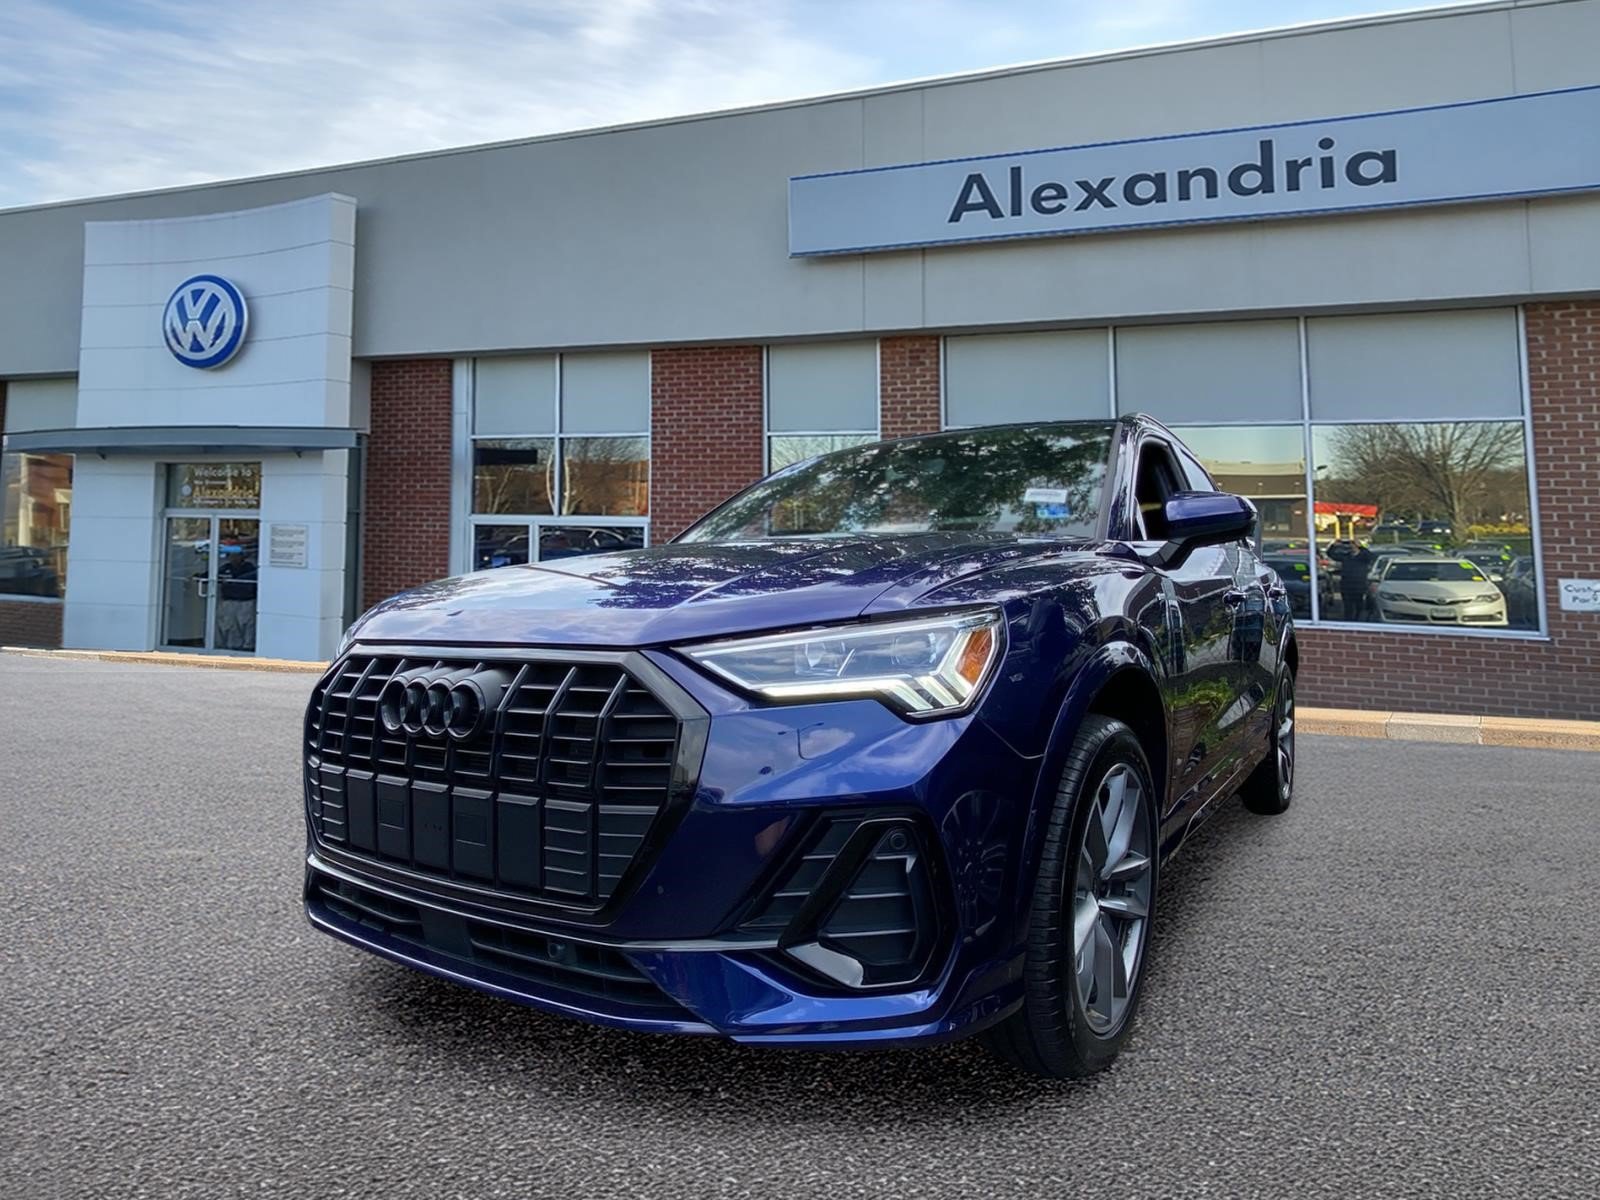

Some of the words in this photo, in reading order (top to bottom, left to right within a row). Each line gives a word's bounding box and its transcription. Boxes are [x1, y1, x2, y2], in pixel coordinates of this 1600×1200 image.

[947, 137, 1398, 224] Alexandria
[166, 280, 238, 361] VW
[1564, 584, 1594, 593] Cust
[1572, 595, 1593, 603] Par
